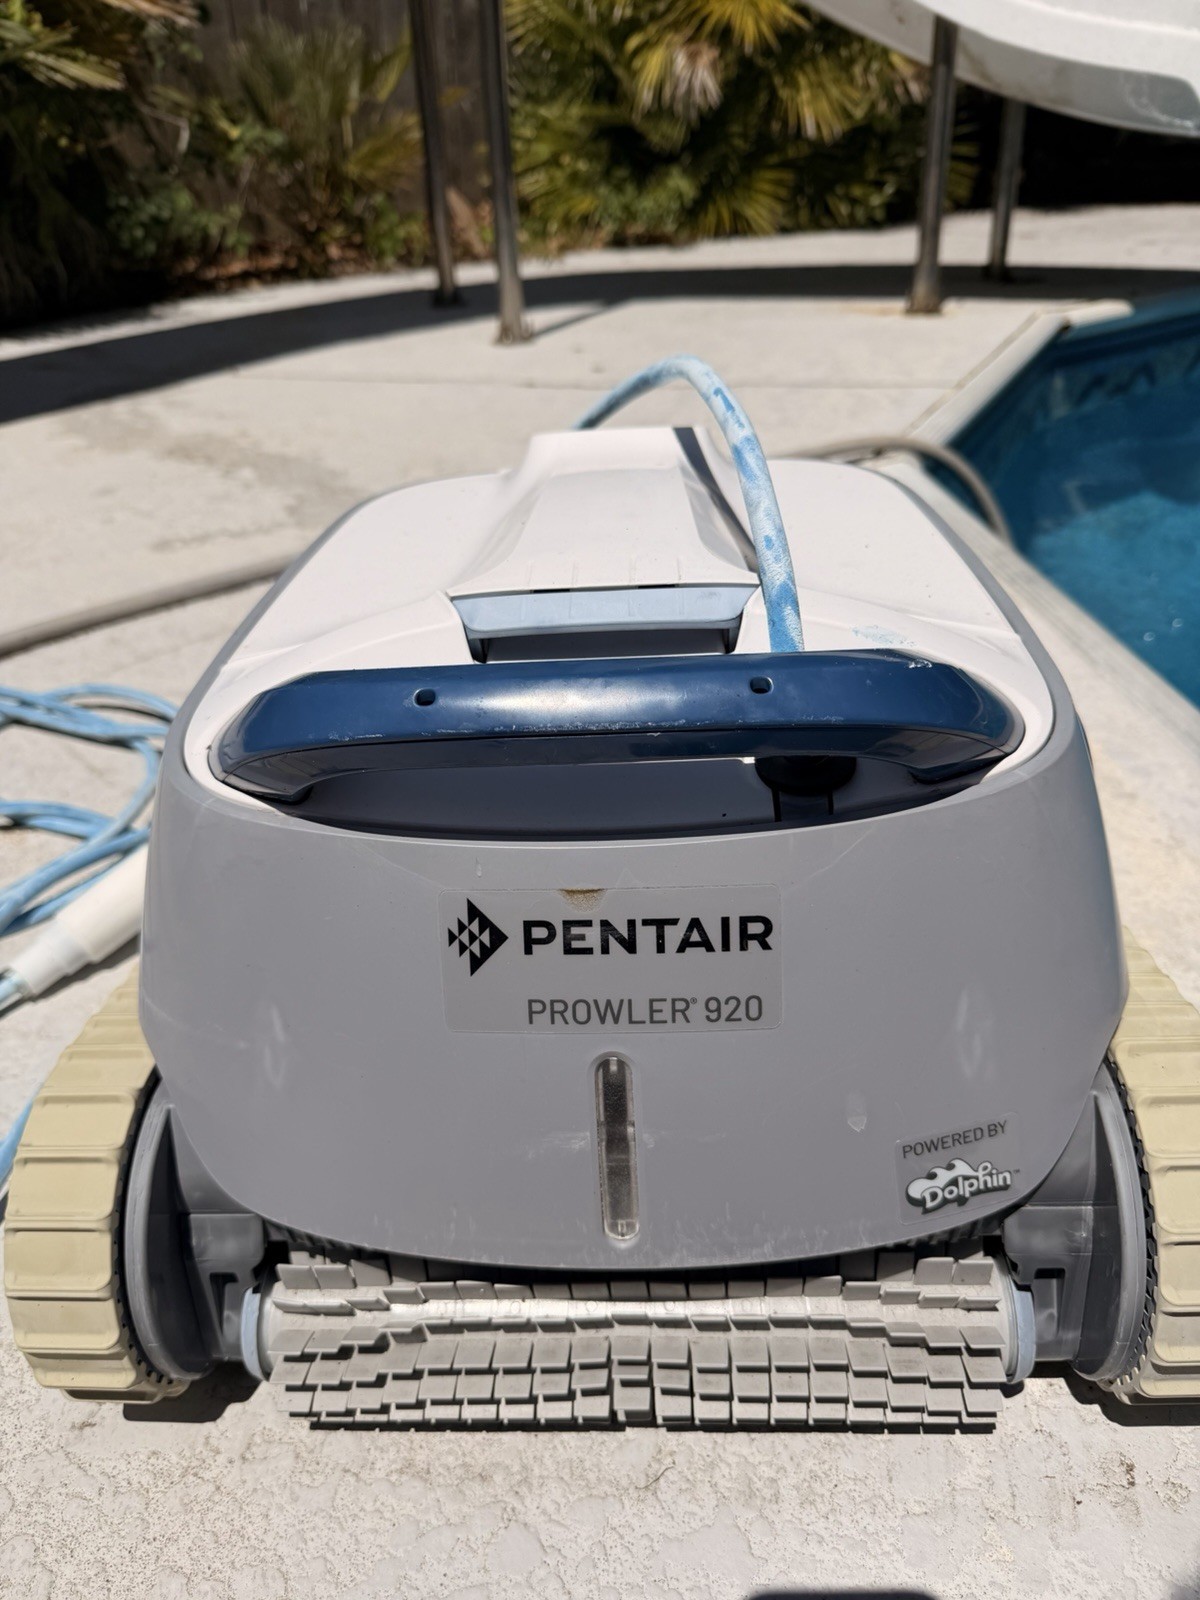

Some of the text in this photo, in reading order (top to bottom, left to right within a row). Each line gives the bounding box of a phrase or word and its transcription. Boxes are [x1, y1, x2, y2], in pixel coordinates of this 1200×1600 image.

[523, 915, 773, 955] PENTAIR
[704, 995, 763, 1023] 920
[902, 1120, 1007, 1159] POWERED BY
[921, 1161, 1012, 1209] Dolphin
